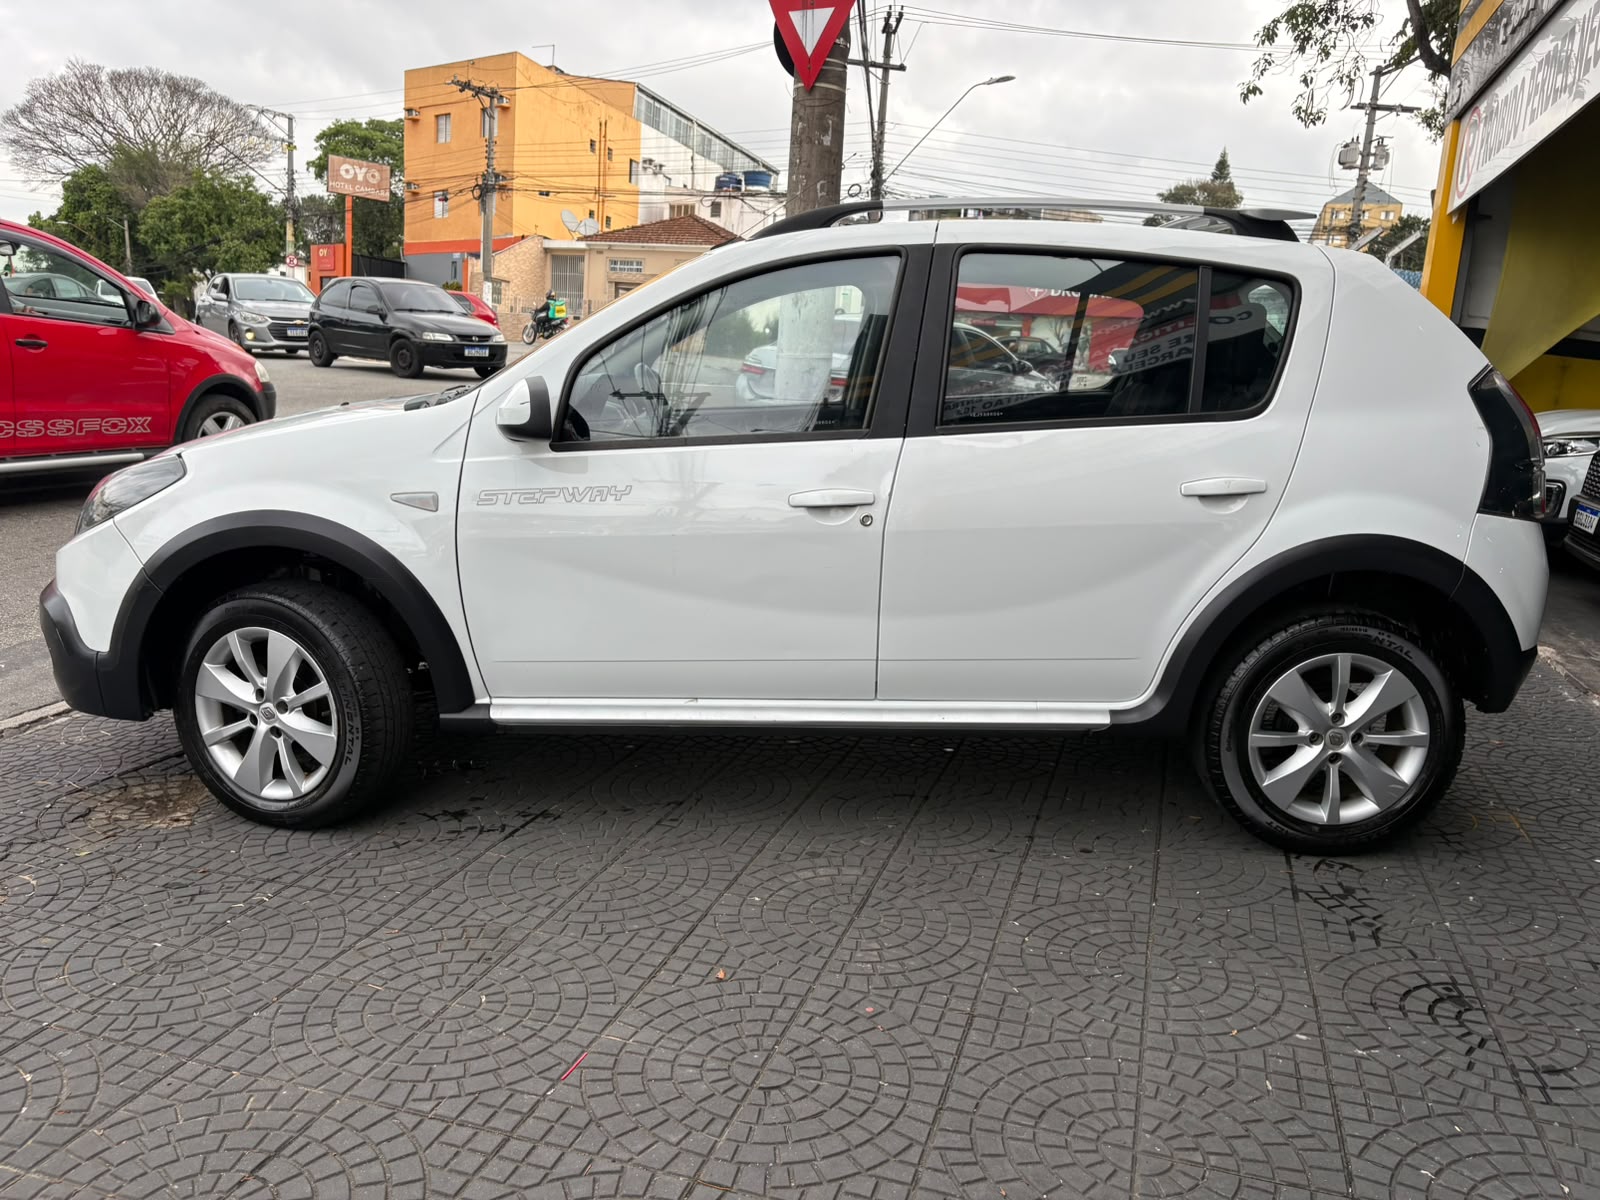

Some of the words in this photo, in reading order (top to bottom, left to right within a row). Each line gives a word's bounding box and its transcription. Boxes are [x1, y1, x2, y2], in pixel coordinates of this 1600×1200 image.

[340, 163, 381, 184] OYO
[329, 180, 353, 191] HOTEL
[476, 485, 633, 506] STEPWAY
